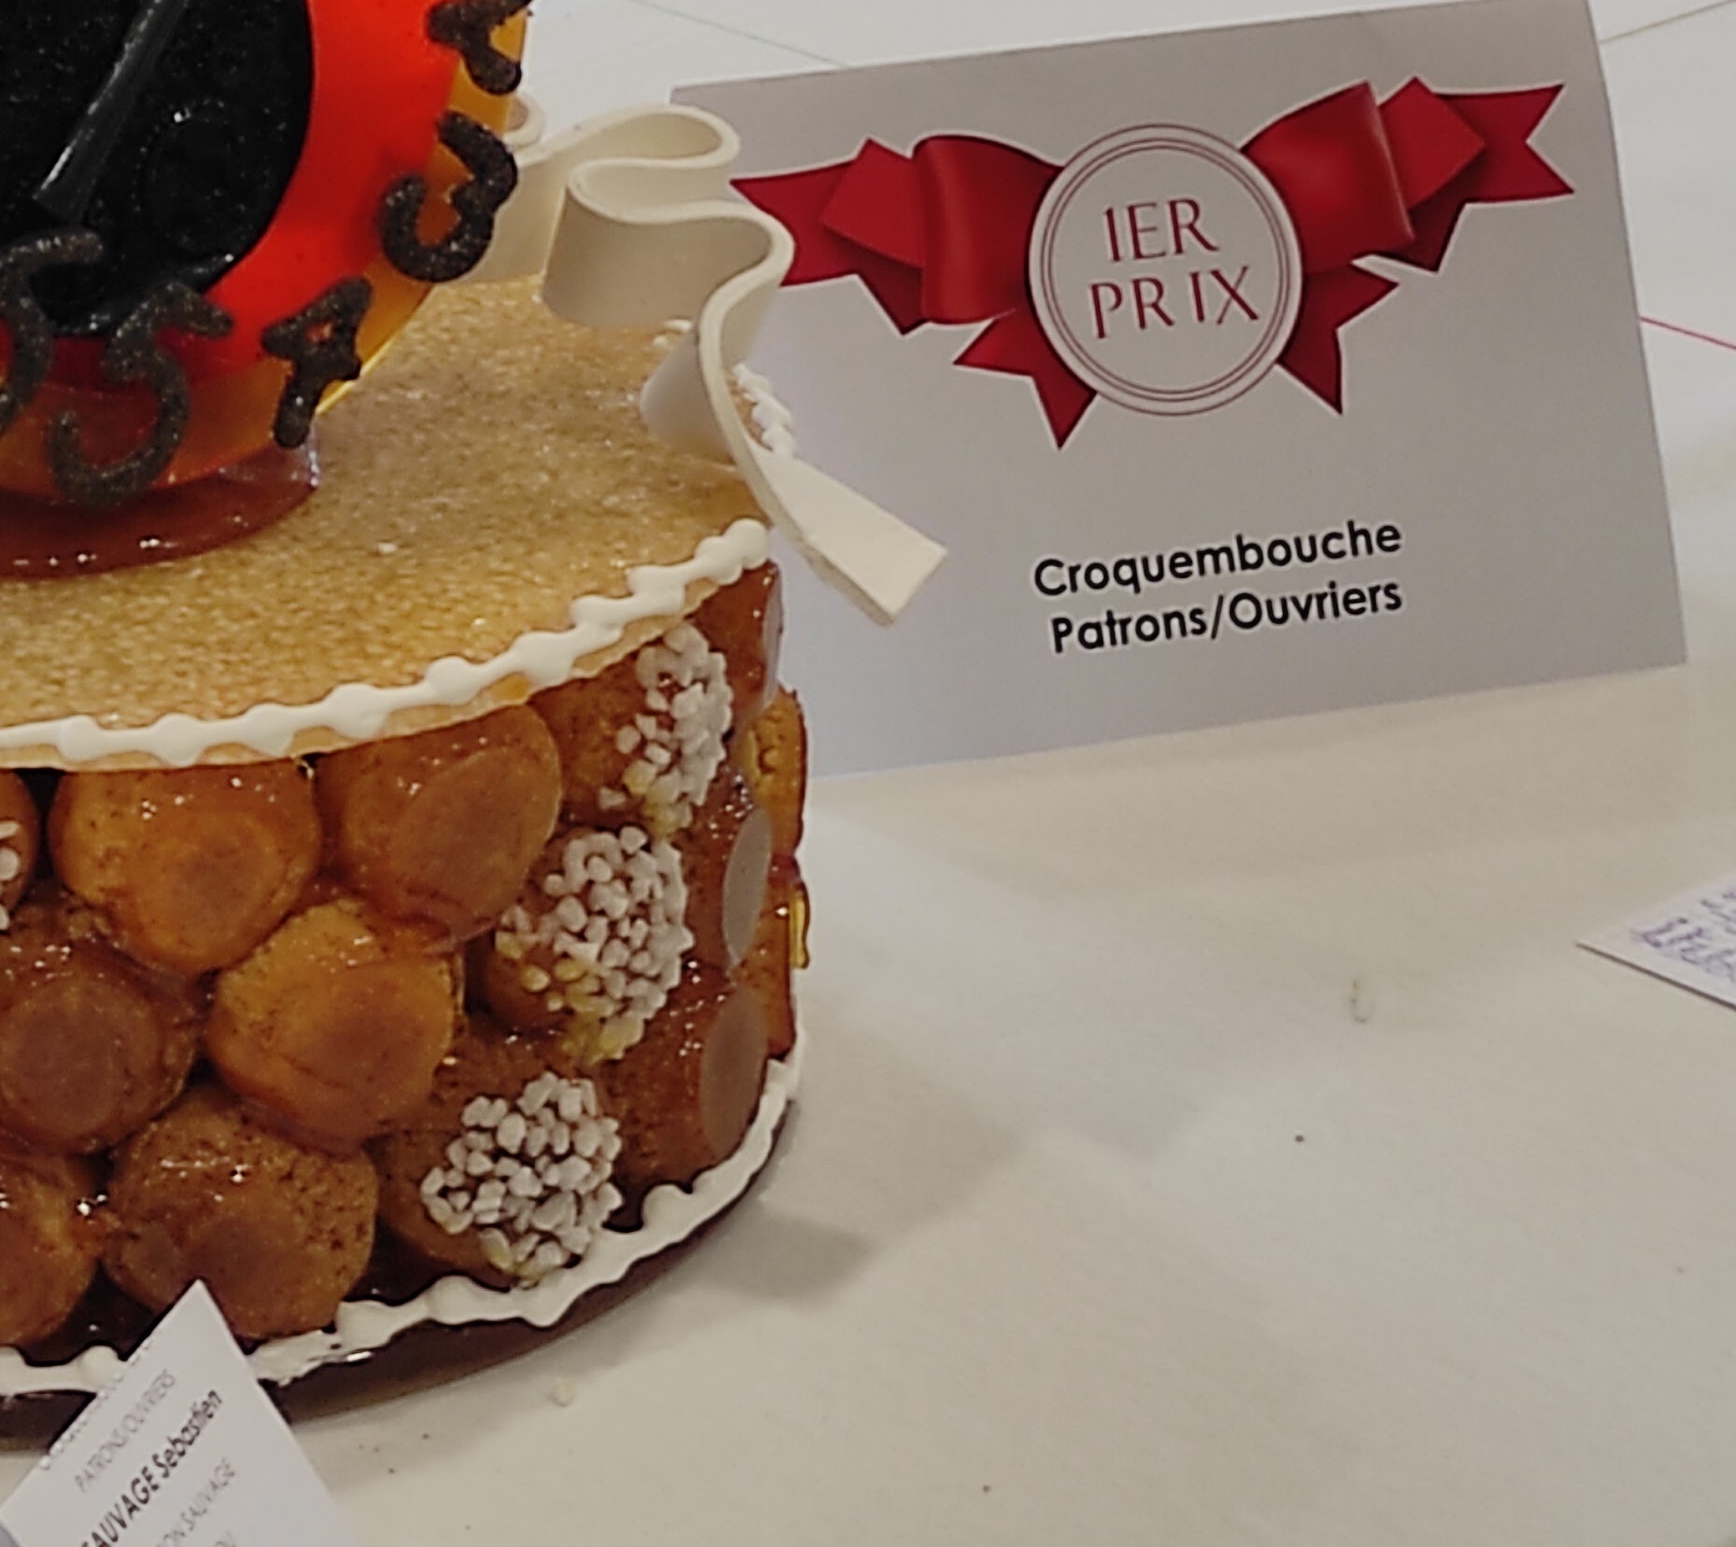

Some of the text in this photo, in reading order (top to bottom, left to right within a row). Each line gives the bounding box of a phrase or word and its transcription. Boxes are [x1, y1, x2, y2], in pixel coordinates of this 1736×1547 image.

[379, 113, 519, 282] 3
[1088, 265, 1260, 339] PRIX
[46, 283, 233, 496] 5
[262, 277, 373, 448] 4
[1034, 519, 1402, 597] Croquembouche
[1051, 580, 1403, 654] Patrons/Ouvriers
[80, 1465, 160, 1547] AUVAGE
